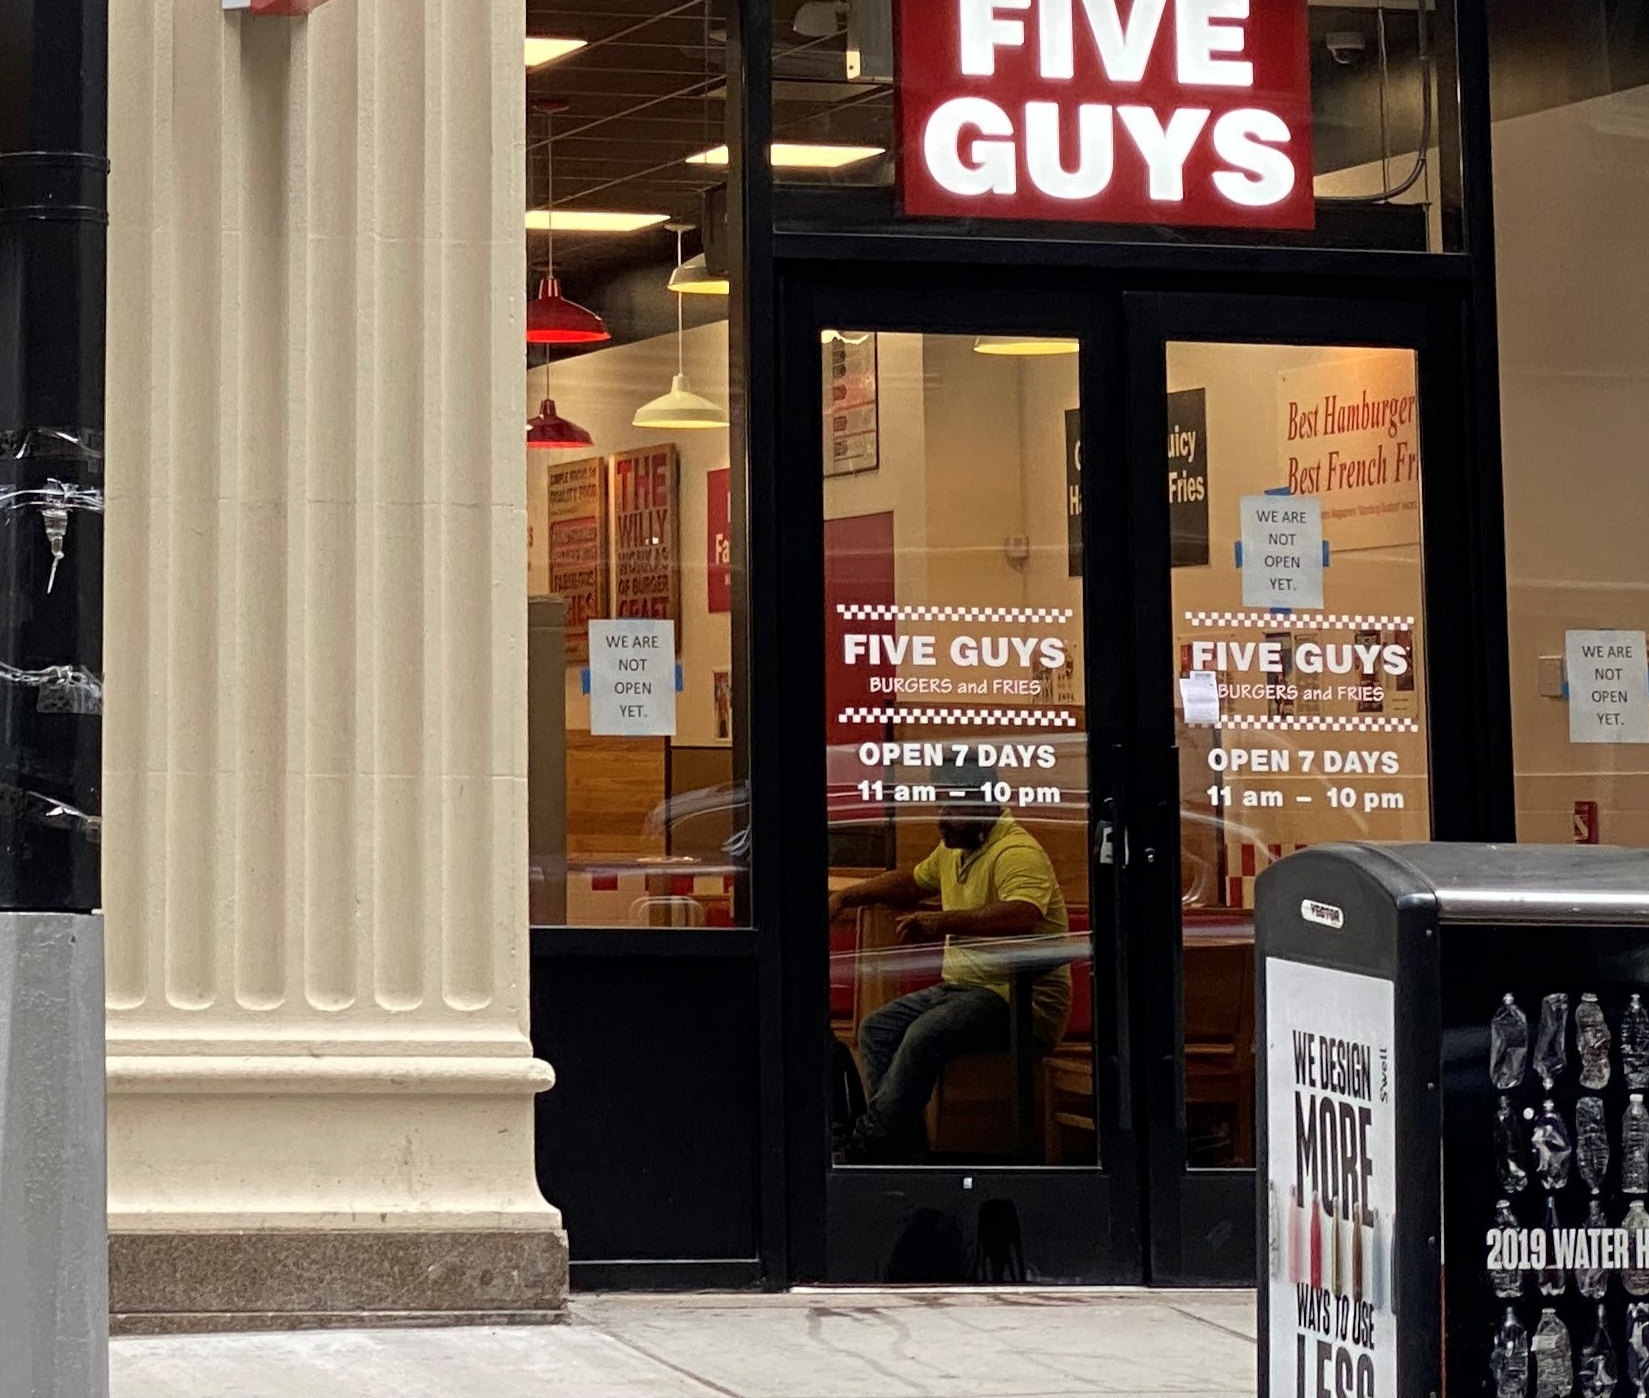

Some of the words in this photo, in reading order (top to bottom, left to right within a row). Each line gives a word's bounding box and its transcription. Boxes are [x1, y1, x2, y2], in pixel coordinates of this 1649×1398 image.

[924, 97, 1295, 206] GUYS
[1287, 402, 1318, 441] Best
[1322, 390, 1415, 439] Hamburger
[1167, 425, 1197, 463] uicy
[617, 453, 667, 512] THE
[1289, 457, 1320, 495] Best
[1326, 445, 1387, 493] French
[1169, 470, 1205, 504] Fries
[1256, 510, 1278, 523] WE
[1281, 511, 1307, 524] ARE
[1268, 533, 1296, 545] NOT
[1264, 555, 1300, 568] OPEN
[1269, 578, 1297, 591] YET.
[605, 635, 630, 649] WE
[632, 635, 659, 649] ARE
[843, 634, 936, 666] FIVE
[950, 636, 1065, 668] GUYS
[1581, 646, 1604, 658] WE
[1607, 646, 1632, 658] ARE
[618, 658, 647, 672] NOT
[1192, 641, 1282, 672] FIVE
[1295, 644, 1408, 675] GUYS
[869, 677, 952, 693] BURGERS
[957, 679, 987, 694] and
[993, 679, 1041, 695] FRIES
[1594, 668, 1622, 681] NOT
[614, 681, 652, 695] OPEN
[1218, 684, 1298, 700] BURGERS
[1303, 687, 1332, 701] and
[1337, 686, 1384, 702] FRIES
[1591, 690, 1628, 703] OPEN
[619, 705, 648, 718] YET.
[1597, 713, 1624, 726] YET.
[859, 742, 943, 766] OPEN
[952, 744, 968, 767] 7
[978, 744, 1056, 768] DAYS
[1208, 748, 1290, 772] OPEN
[1298, 750, 1315, 773] 7
[1323, 751, 1399, 774] DAYS
[857, 780, 883, 801] 11
[894, 784, 936, 801] am
[980, 782, 1011, 802] 10
[1019, 786, 1060, 807] pm
[1206, 785, 1232, 807] 11
[1242, 790, 1284, 807] am
[1326, 787, 1357, 808] 10
[1364, 791, 1405, 812] pm
[1292, 1029, 1317, 1088] WE
[1319, 1035, 1371, 1101] DESIGN
[1294, 1090, 1374, 1229] MORE
[1486, 1227, 1547, 1270] 2019
[1552, 1228, 1630, 1269] WATER
[1297, 1282, 1331, 1337] WAYS
[1335, 1294, 1350, 1342] TO
[1353, 1300, 1375, 1351] USE
